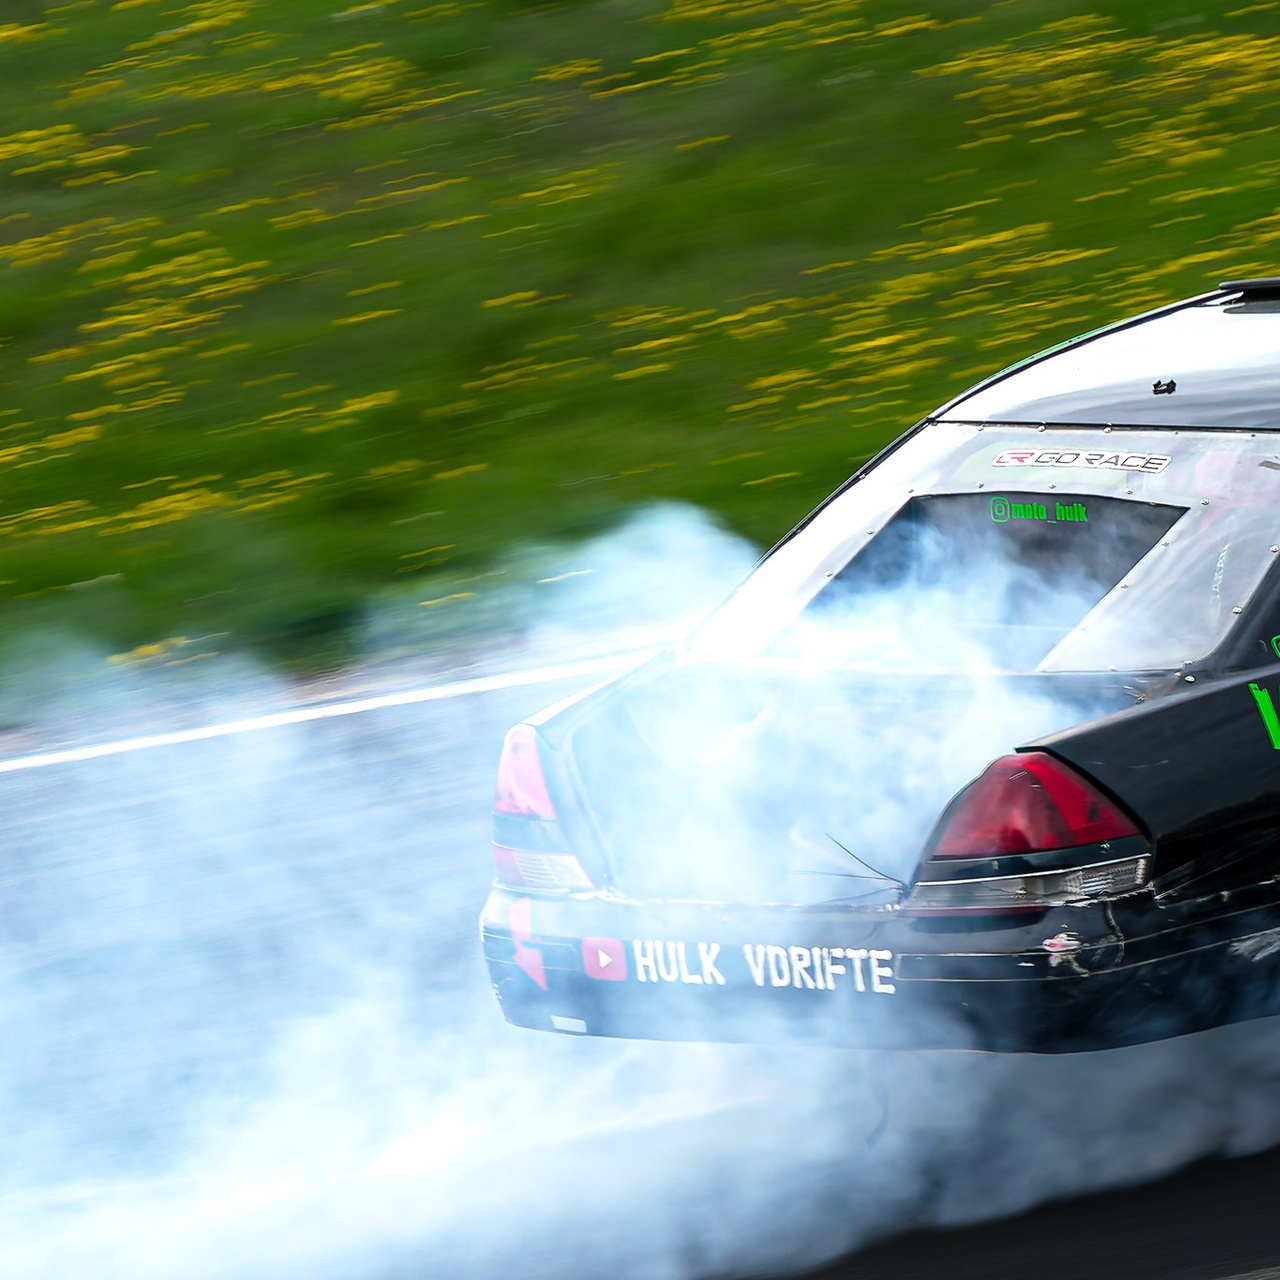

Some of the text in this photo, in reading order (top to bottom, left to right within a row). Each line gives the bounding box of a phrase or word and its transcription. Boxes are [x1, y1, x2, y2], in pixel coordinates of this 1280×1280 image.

[1085, 453, 1168, 471] RACE
[1011, 502, 1088, 524] moto_hulk
[632, 938, 897, 995] HULK VDRIFTE
